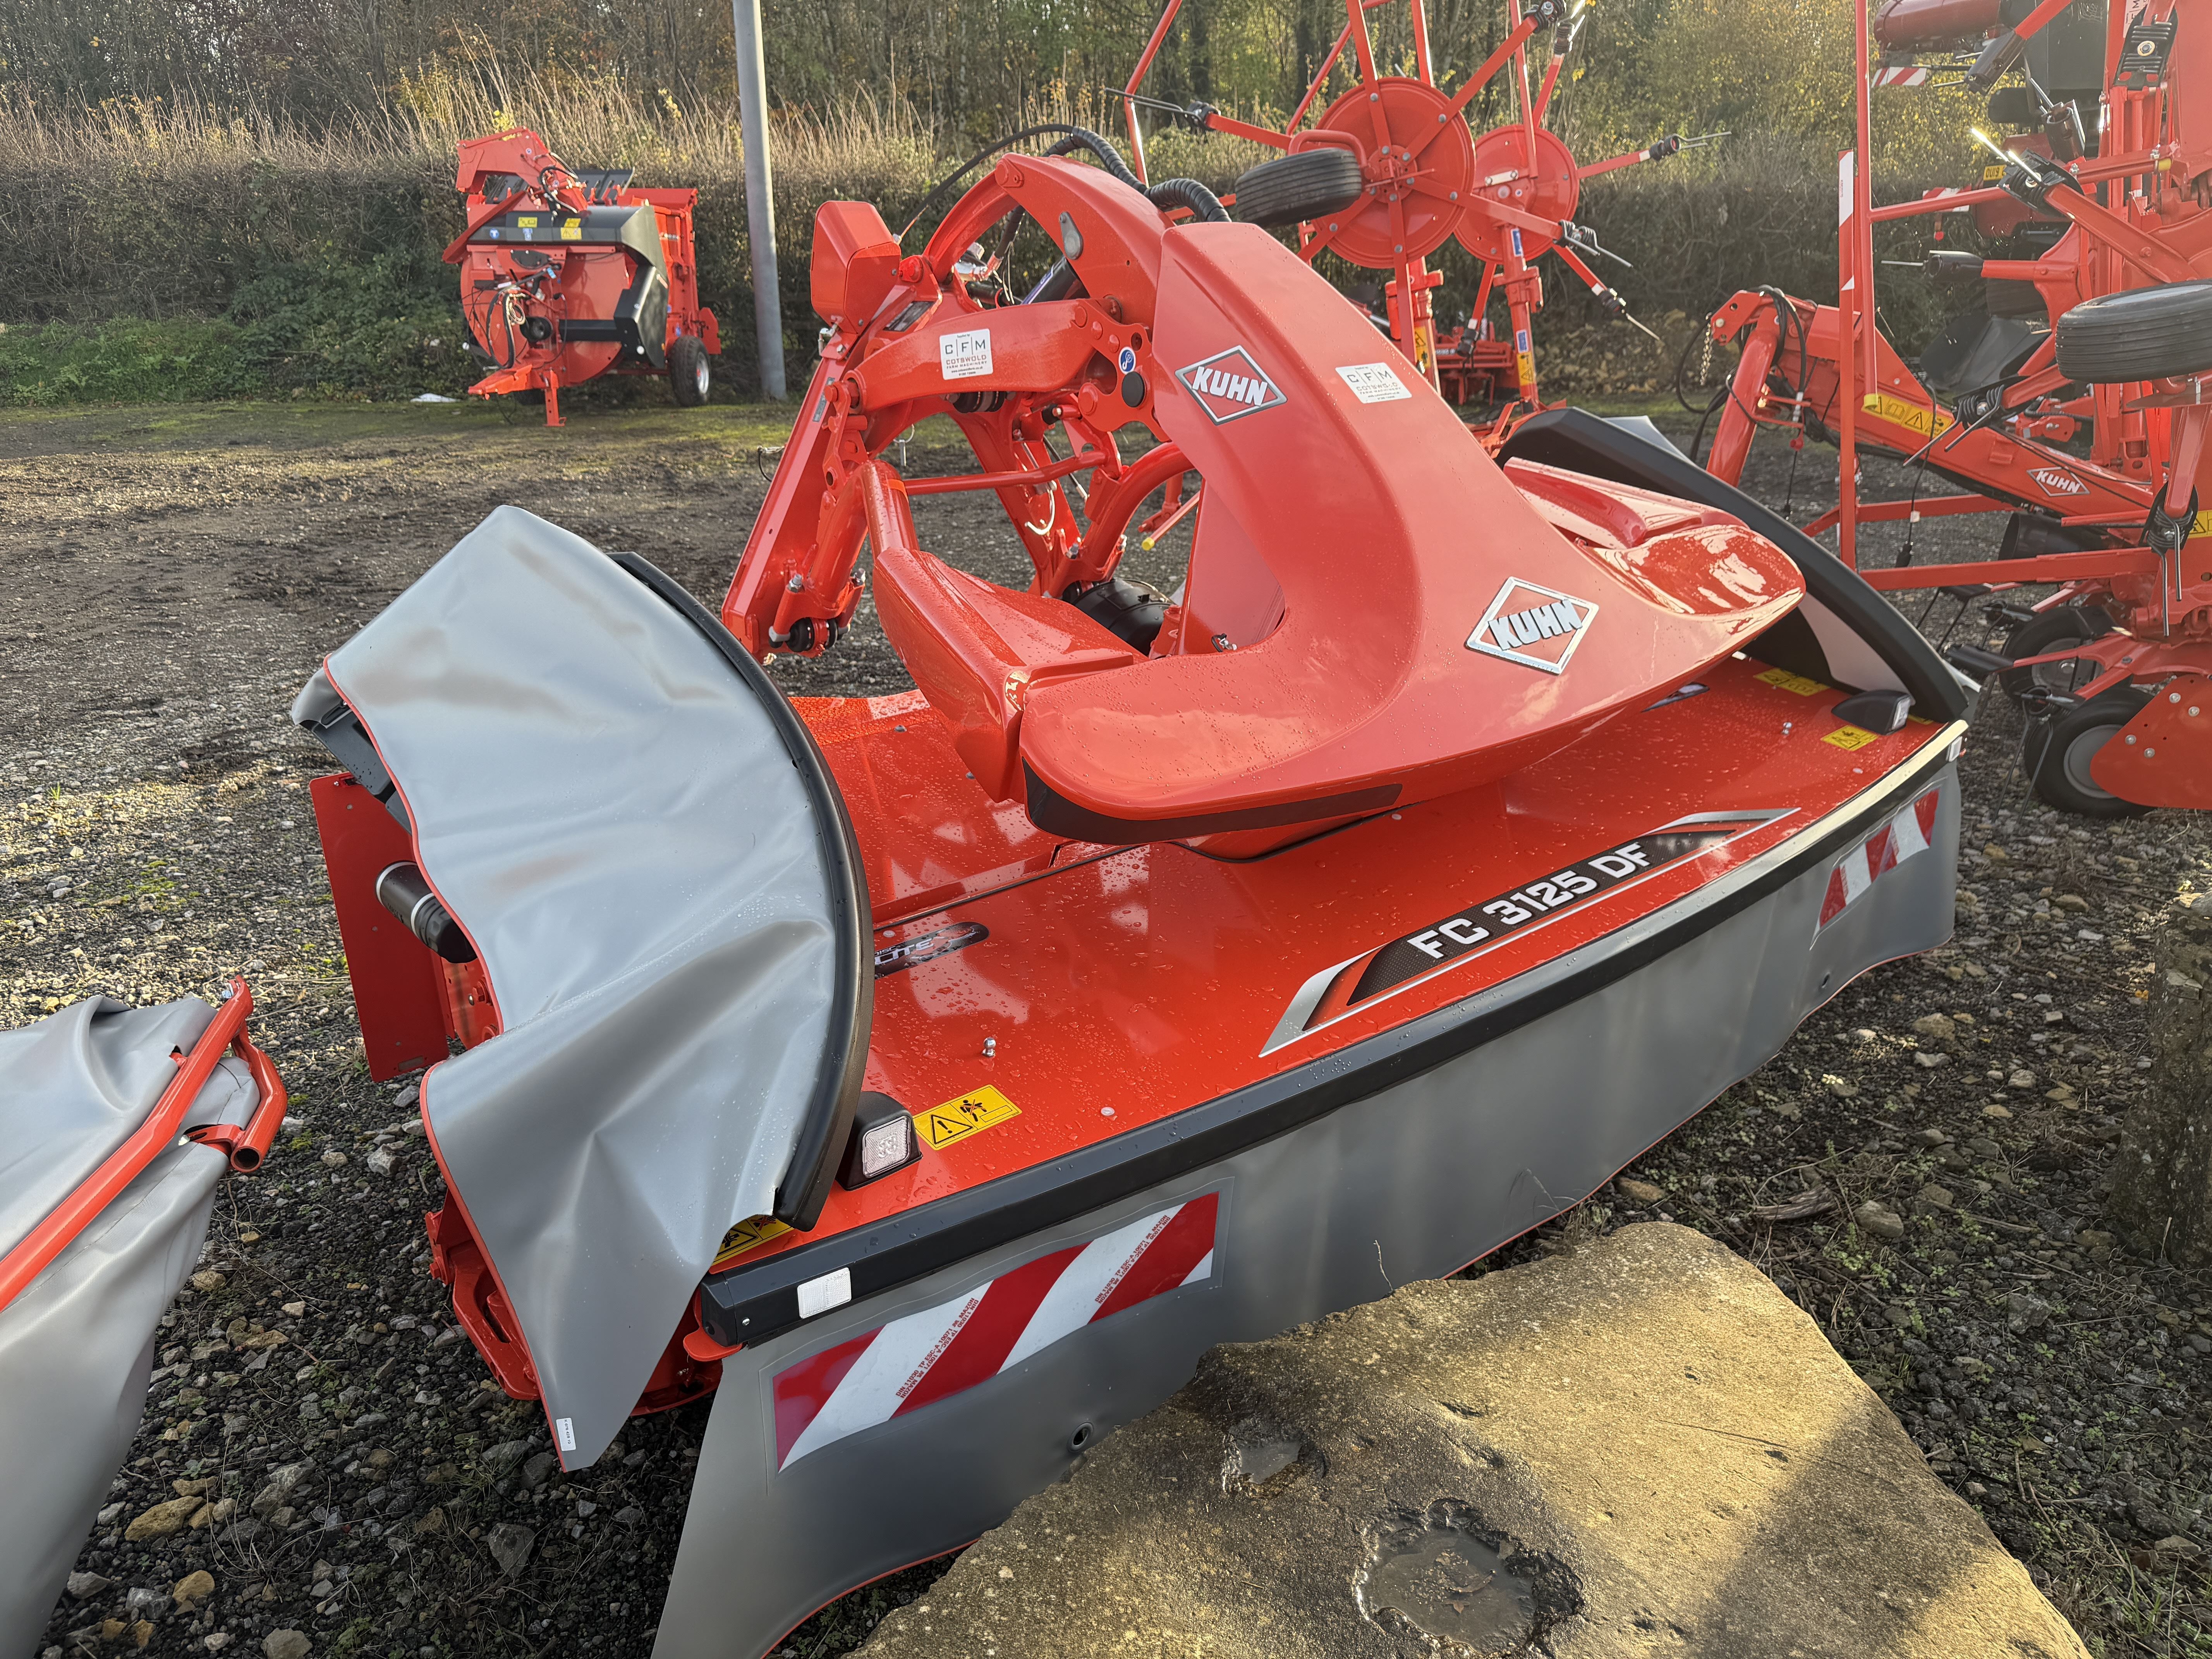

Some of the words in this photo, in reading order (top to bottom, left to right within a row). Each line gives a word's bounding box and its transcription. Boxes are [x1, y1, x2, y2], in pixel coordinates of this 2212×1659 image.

[946, 355, 986, 365] COTSWOLD
[1192, 366, 1268, 407] KUHN
[2036, 471, 2081, 493] KUHN
[1487, 599, 1583, 651] KUHN
[1407, 918, 1489, 959] FC
[1482, 870, 1597, 925] 3125
[1588, 842, 1650, 878] DF
[1162, 1217, 1171, 1226] DIN
[1149, 1226, 1162, 1240] 11030
[1095, 1292, 1103, 1302] DIN
[1103, 1278, 1115, 1292] 11030
[1120, 1254, 1134, 1269] ESC-A
[1133, 1240, 1146, 1254] 10071
[1151, 1214, 1168, 1232] MAZON
[1098, 1286, 1113, 1304] MAZON
[957, 1311, 971, 1328] 11030
[895, 1386, 906, 1396] DIN
[904, 1370, 919, 1386] 11030
[924, 1344, 939, 1360] ESC-A
[938, 1328, 953, 1343] 10071
[959, 1298, 975, 1319] MAZON
[936, 1337, 952, 1353] ESC-A
[923, 1354, 938, 1370] 10071
[900, 1379, 918, 1398] MAZON
